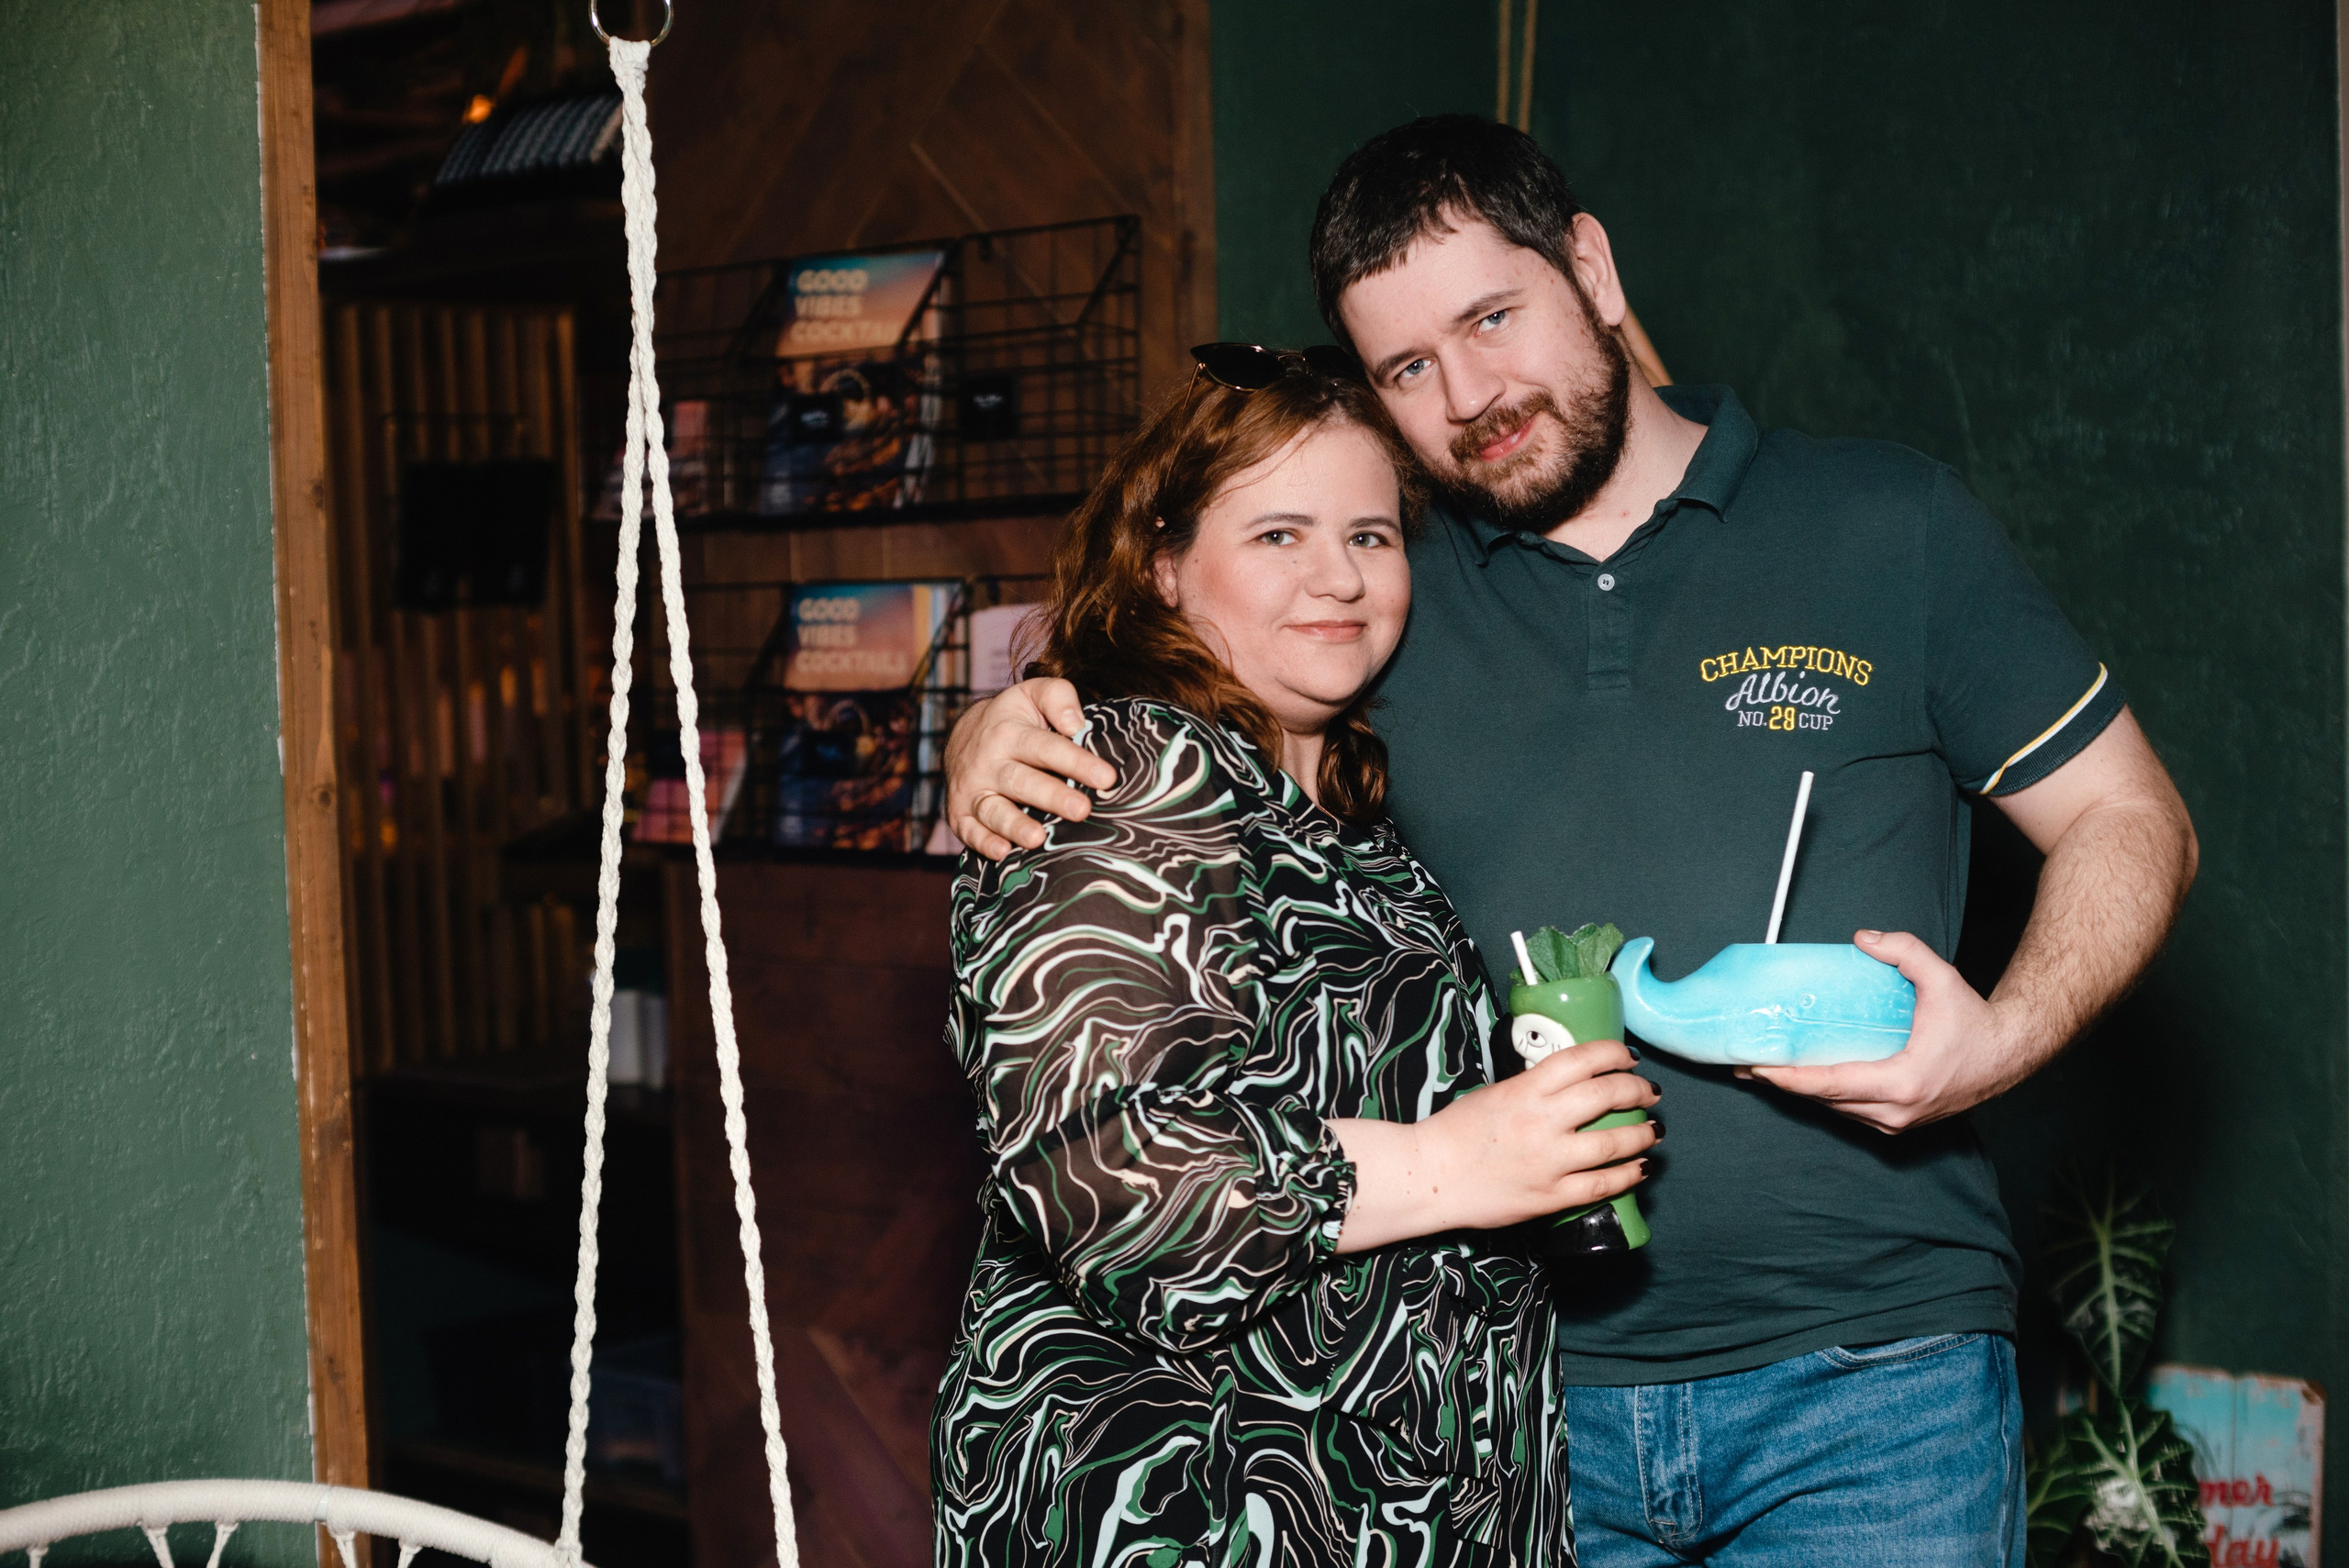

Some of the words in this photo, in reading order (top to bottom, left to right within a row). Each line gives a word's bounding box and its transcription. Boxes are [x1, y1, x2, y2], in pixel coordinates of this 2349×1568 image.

[796, 268, 870, 293] GOOD
[795, 295, 863, 317] VIBES
[798, 597, 861, 621] GOOD
[797, 625, 856, 647] VIBES
[1700, 646, 1875, 686] CHAMPIONS
[1725, 671, 1841, 715] Albion
[1798, 712, 1833, 730] CUP
[2198, 1473, 2276, 1507] mer
